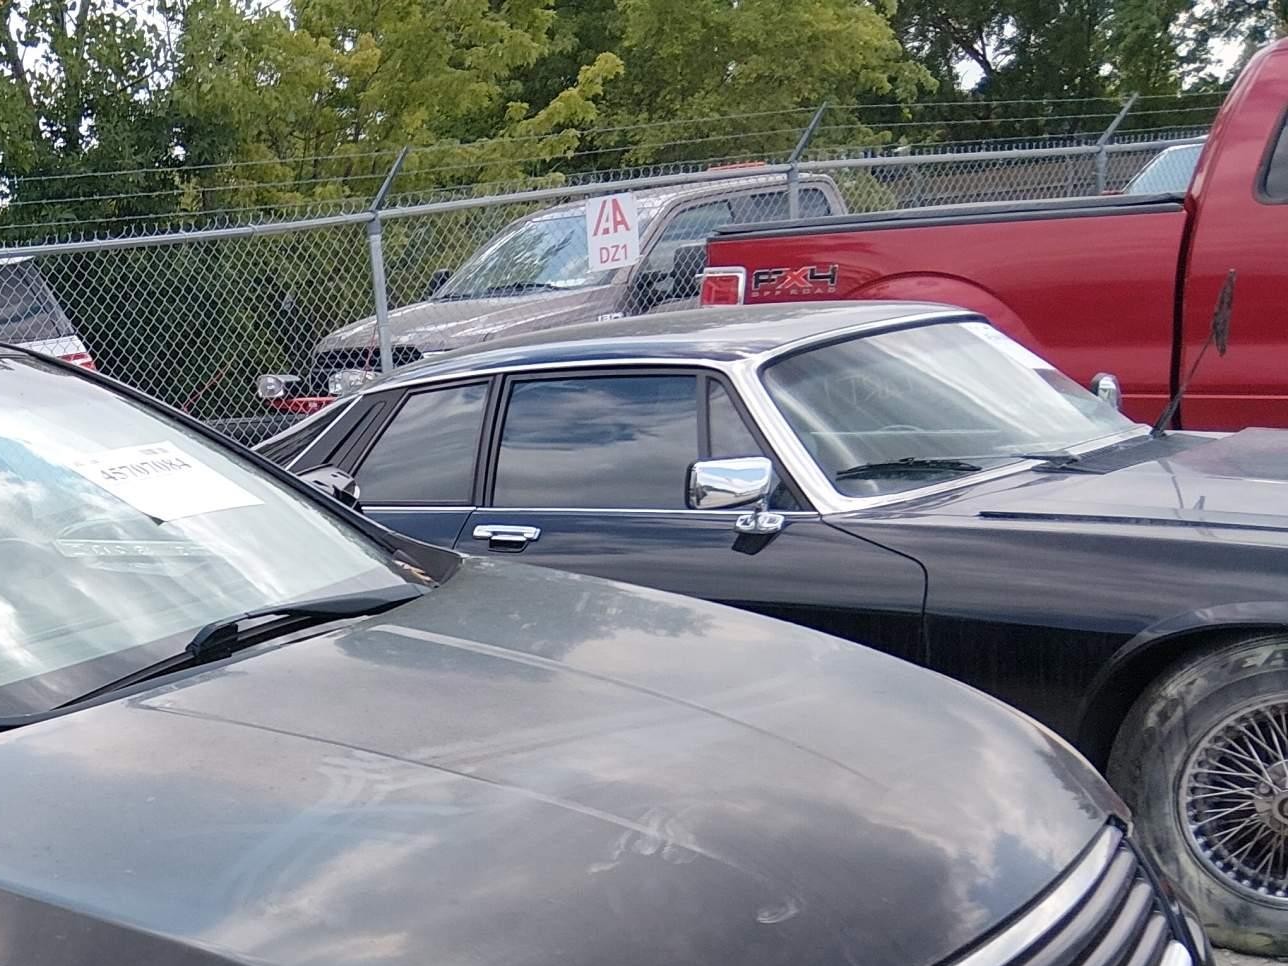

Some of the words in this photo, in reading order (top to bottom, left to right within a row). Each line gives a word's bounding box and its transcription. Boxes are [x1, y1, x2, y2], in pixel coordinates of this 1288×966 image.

[599, 244, 628, 264] DZ1
[752, 264, 839, 291] FX4
[100, 457, 193, 482] 45707084
